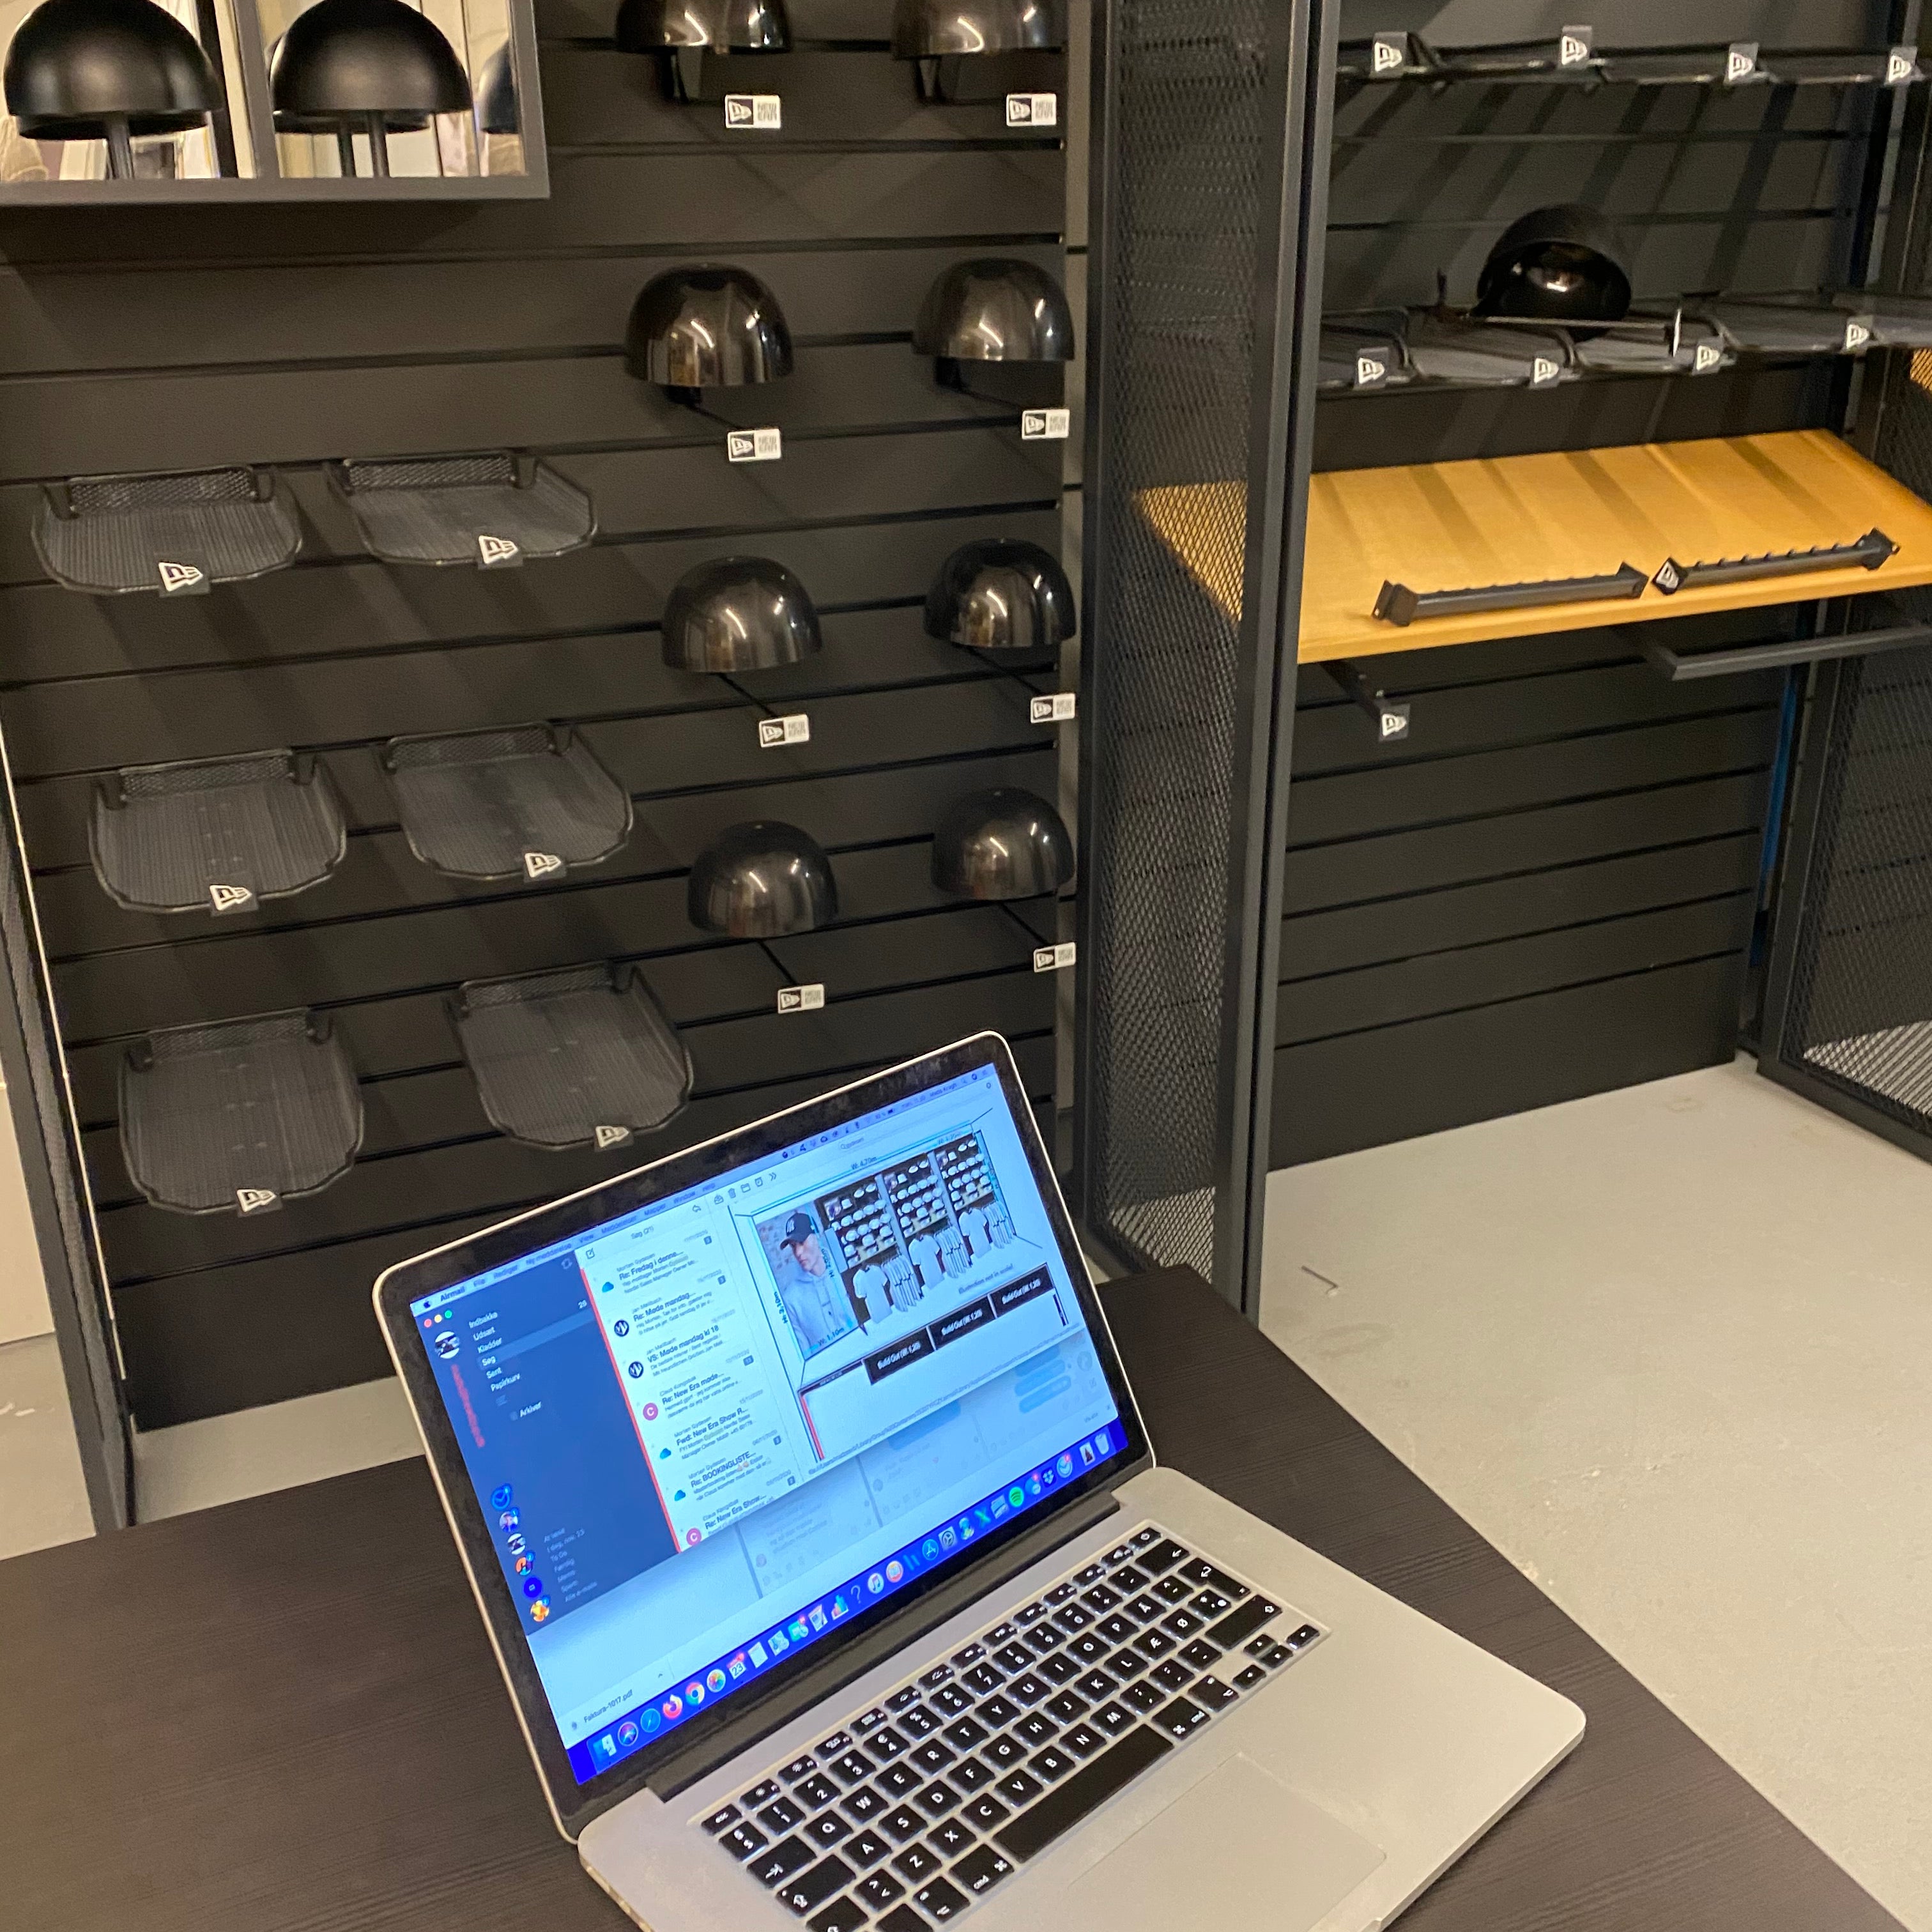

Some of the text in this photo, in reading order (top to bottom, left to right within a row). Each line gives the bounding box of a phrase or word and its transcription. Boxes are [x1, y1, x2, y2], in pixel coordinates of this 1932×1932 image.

[619, 1271, 631, 1280] Re:
[631, 1261, 654, 1276] Fredag
[440, 1287, 465, 1301] Airmail
[469, 1312, 498, 1328] Indbakke
[633, 1312, 645, 1321] Re:
[478, 1338, 503, 1353] Kladder
[648, 1353, 659, 1362] VS:
[678, 1333, 704, 1349] mandag
[482, 1356, 496, 1367] Søg
[486, 1367, 502, 1378] Sent
[491, 1374, 521, 1392] Papirkurv
[662, 1395, 673, 1404] Re:
[674, 1388, 688, 1398] New
[689, 1382, 700, 1390] Era
[519, 1402, 543, 1416] Arkiver
[647, 1407, 655, 1416] C
[677, 1434, 692, 1445] Fwd:
[693, 1427, 707, 1437] New
[708, 1420, 719, 1429] Era
[719, 1411, 737, 1423] Show
[691, 1478, 702, 1487] Re:
[705, 1519, 716, 1529] Re:
[717, 1511, 732, 1522] New
[732, 1505, 742, 1514] Era
[689, 1532, 698, 1542] C
[732, 1663, 744, 1676] 23
[817, 1790, 827, 1799] 2
[853, 1767, 862, 1775] 3
[889, 1742, 896, 1751] 4
[921, 1720, 930, 1728] 5
[954, 1698, 962, 1706] 6
[984, 1676, 992, 1685] 7
[822, 1823, 835, 1833] Q
[856, 1796, 871, 1809] W
[894, 1774, 904, 1784] E
[928, 1751, 939, 1760] R
[960, 1728, 969, 1736] T
[1023, 1683, 1034, 1692] U
[1084, 1643, 1094, 1651] O
[862, 1844, 873, 1854] A
[898, 1818, 908, 1827] S
[931, 1793, 943, 1803] D
[966, 1769, 974, 1778] F
[999, 1745, 1010, 1754] G
[1030, 1722, 1042, 1733] H
[1064, 1701, 1071, 1710] J
[1091, 1679, 1103, 1689] K
[1177, 1618, 1188, 1628] Ø
[910, 1712, 1121, 1867] Z X C V B N M
